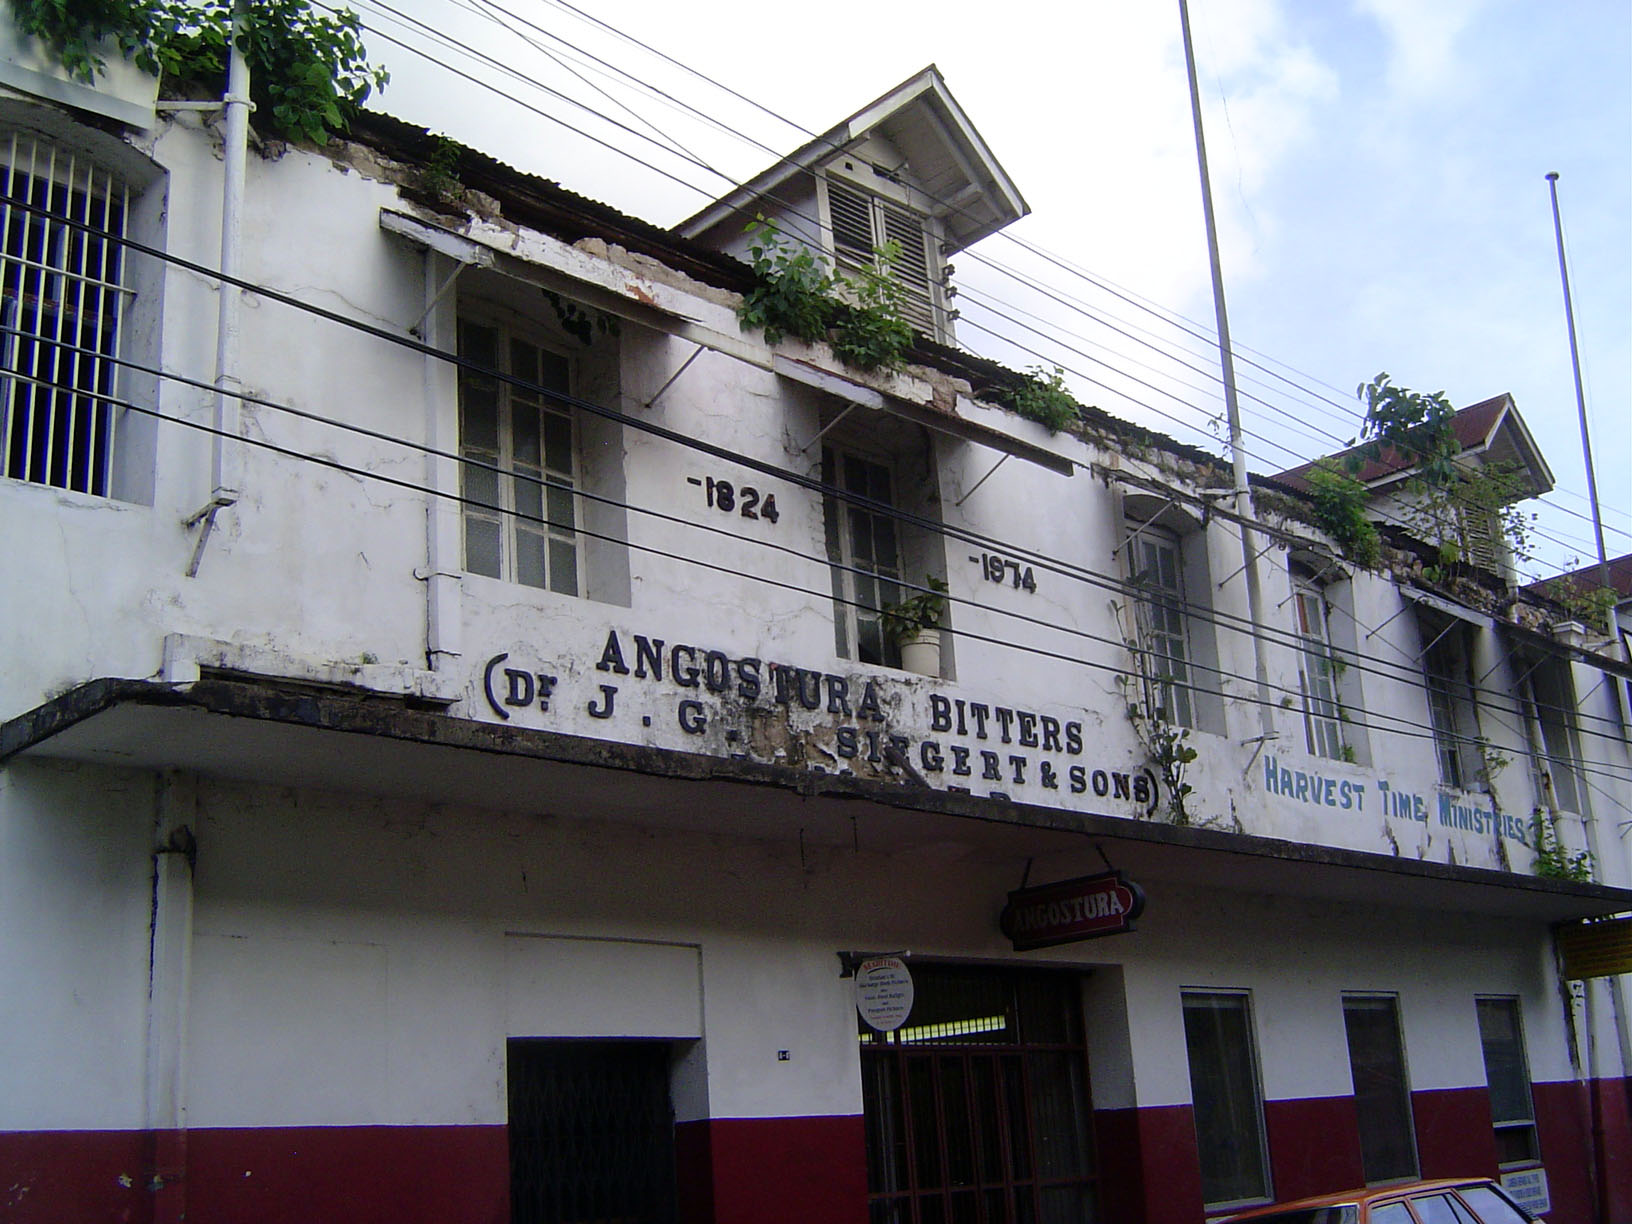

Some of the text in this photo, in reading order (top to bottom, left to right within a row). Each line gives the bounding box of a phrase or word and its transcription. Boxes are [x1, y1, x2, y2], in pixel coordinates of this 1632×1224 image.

[596, 630, 1083, 754] ANGOSTURA BITTERS
[1040, 761, 1058, 790] &
[1264, 755, 1365, 811] HARVEST
[1378, 780, 1427, 822] TIME
[1013, 890, 1125, 929] ANGOSTURA
